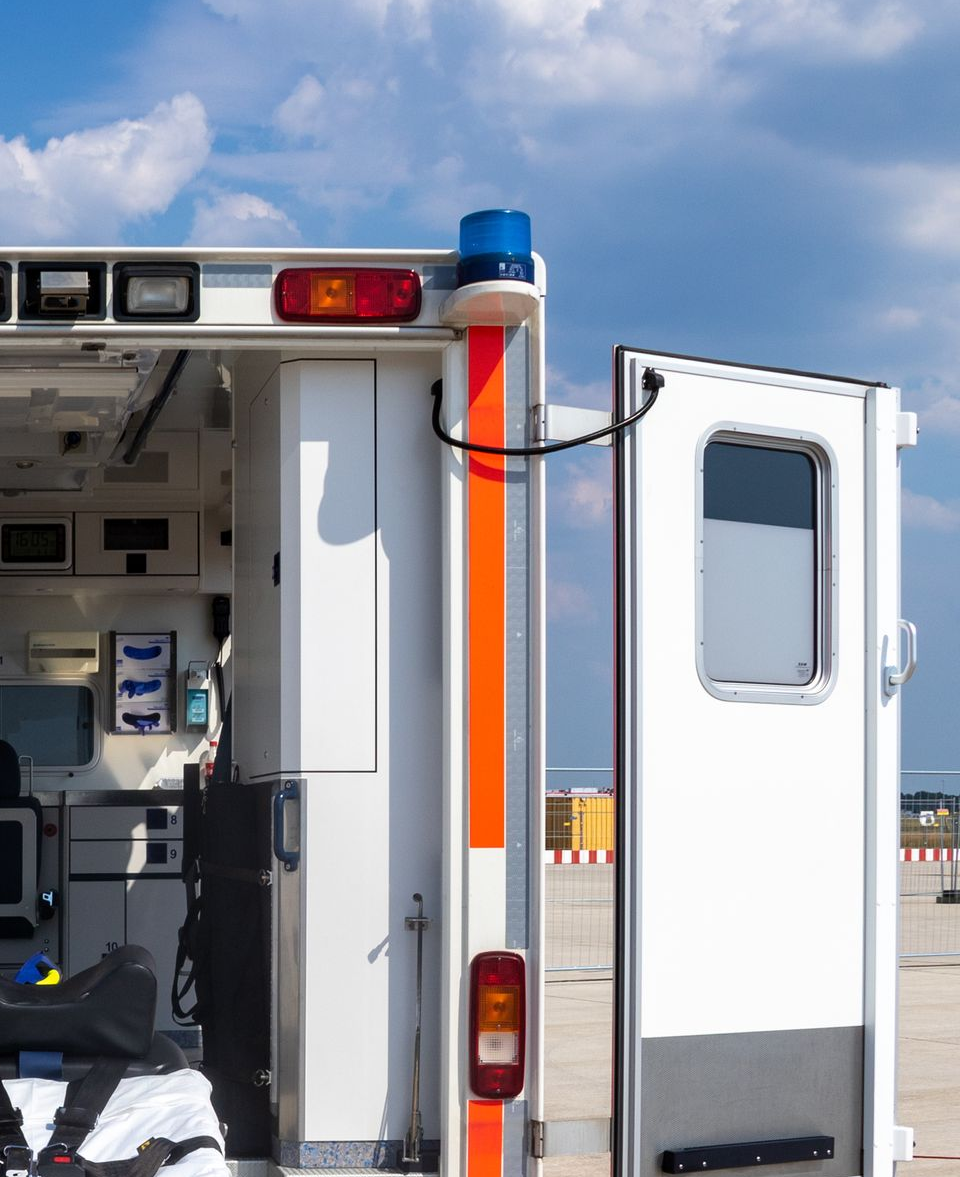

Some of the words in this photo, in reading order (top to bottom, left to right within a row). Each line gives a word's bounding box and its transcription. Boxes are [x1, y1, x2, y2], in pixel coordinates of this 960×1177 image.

[170, 815, 178, 825] 8
[170, 849, 177, 859] 9
[105, 941, 119, 951] 10
